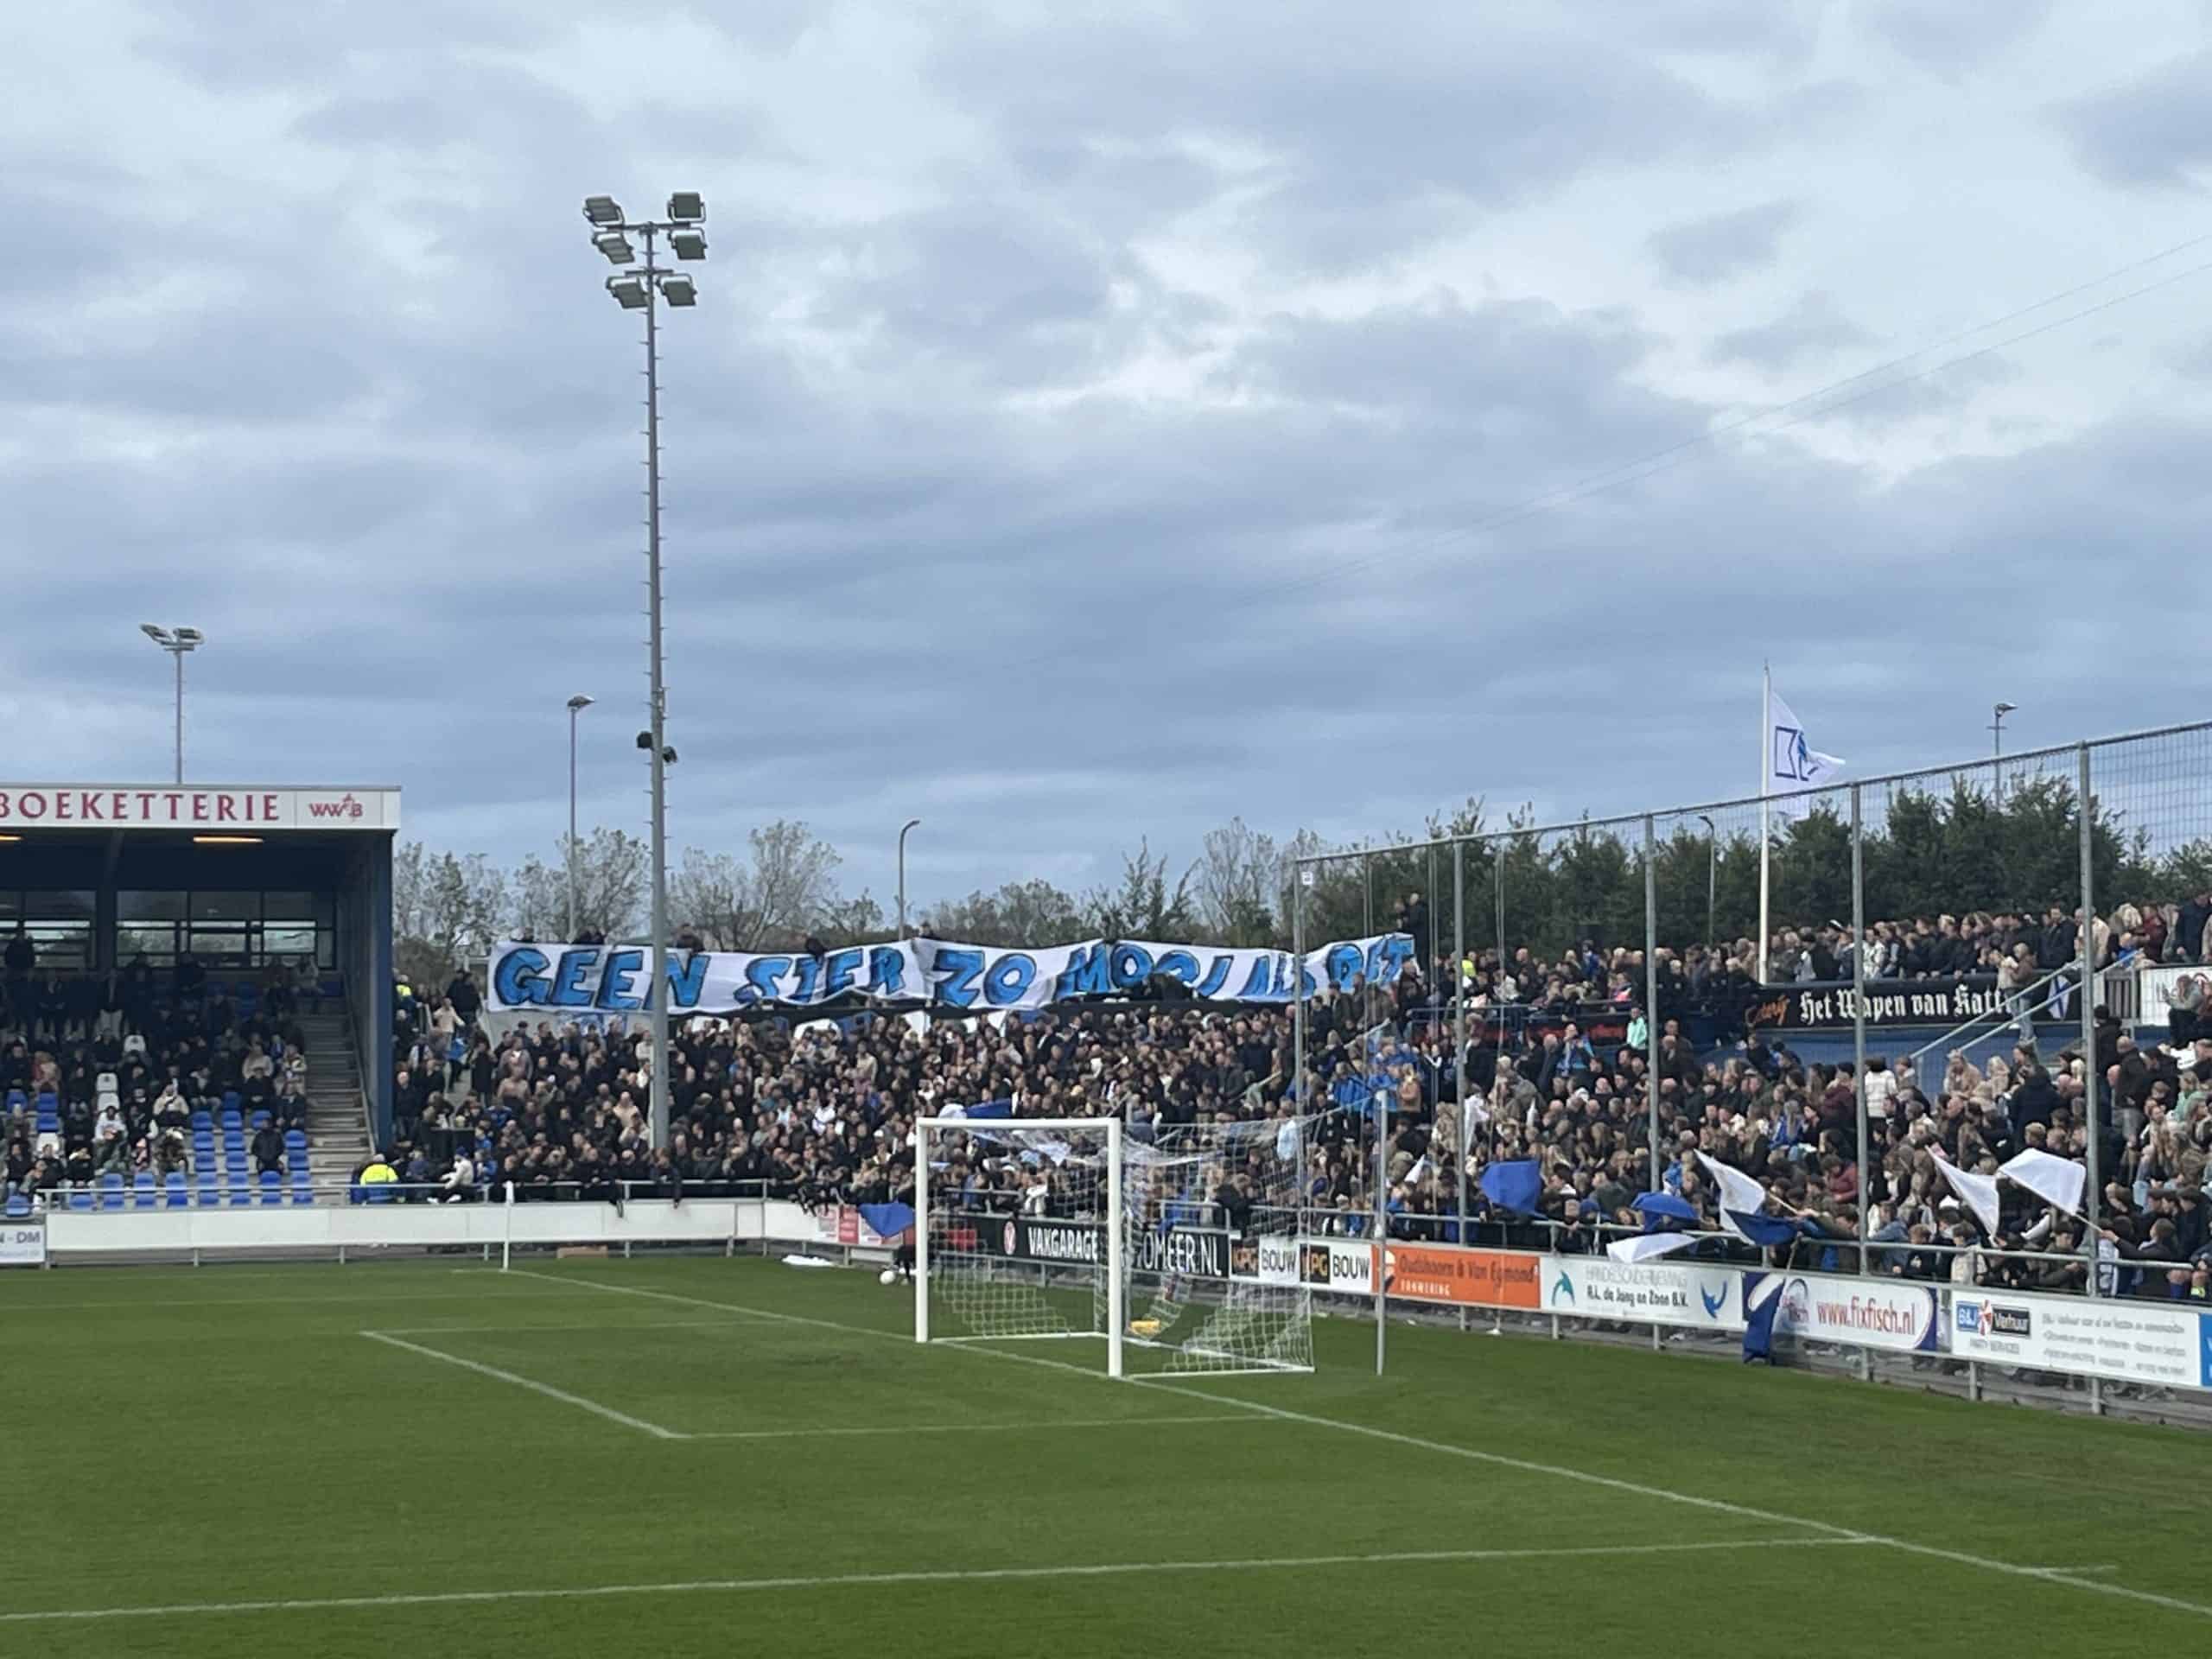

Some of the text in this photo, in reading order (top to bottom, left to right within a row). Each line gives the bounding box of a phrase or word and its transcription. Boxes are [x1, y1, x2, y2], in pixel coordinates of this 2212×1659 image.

[494, 950, 712, 1011] GEEN
[734, 947, 906, 1002] SIER
[933, 950, 1037, 1007] ZO
[1053, 942, 1235, 1001] MOOI
[1800, 990, 1832, 1025] Het
[1836, 988, 1906, 1022] Wapen
[1910, 991, 1948, 1016] van
[1262, 1249, 1296, 1273] BOUW
[1333, 1255, 1370, 1280] BOUW
[1816, 1295, 1916, 1335] www.fixfisch.nl
